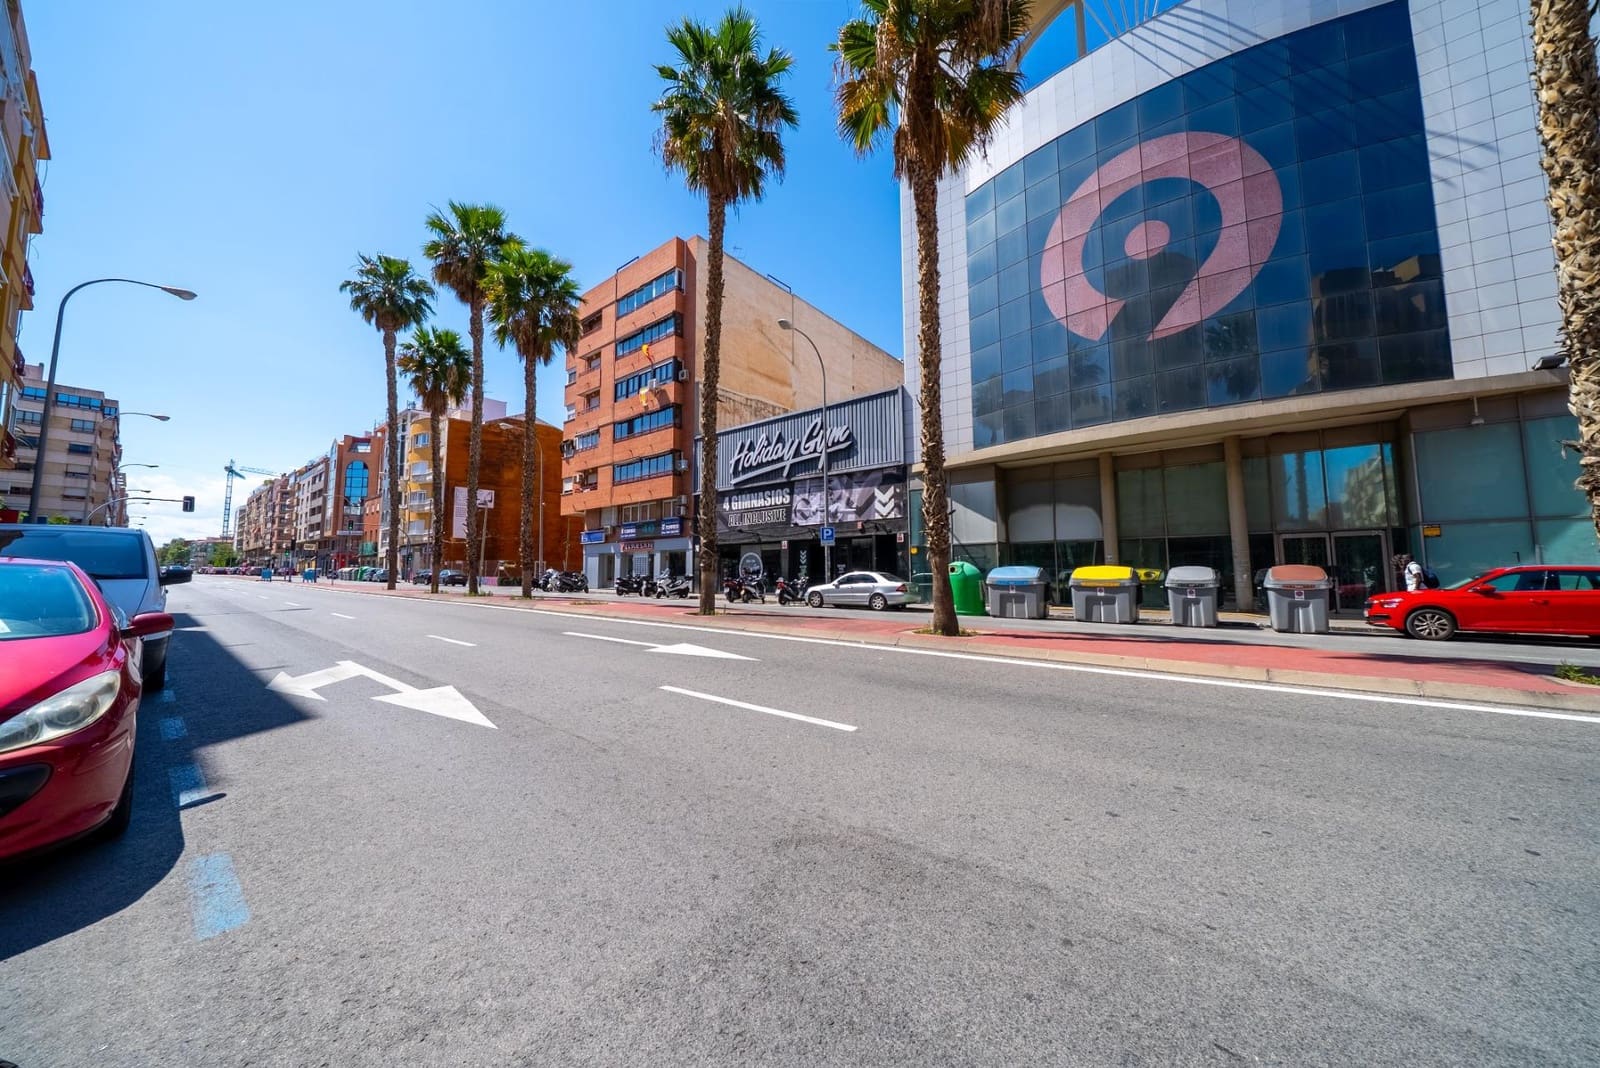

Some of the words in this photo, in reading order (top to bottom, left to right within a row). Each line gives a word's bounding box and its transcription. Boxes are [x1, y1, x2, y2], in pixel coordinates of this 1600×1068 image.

[730, 430, 799, 478] Holiday
[800, 417, 850, 469] Gym
[723, 496, 730, 511] 4
[731, 488, 790, 510] GIMNASIOS
[728, 513, 742, 527] ALL
[742, 508, 786, 525] INCLUSIVE
[823, 528, 833, 540] P
